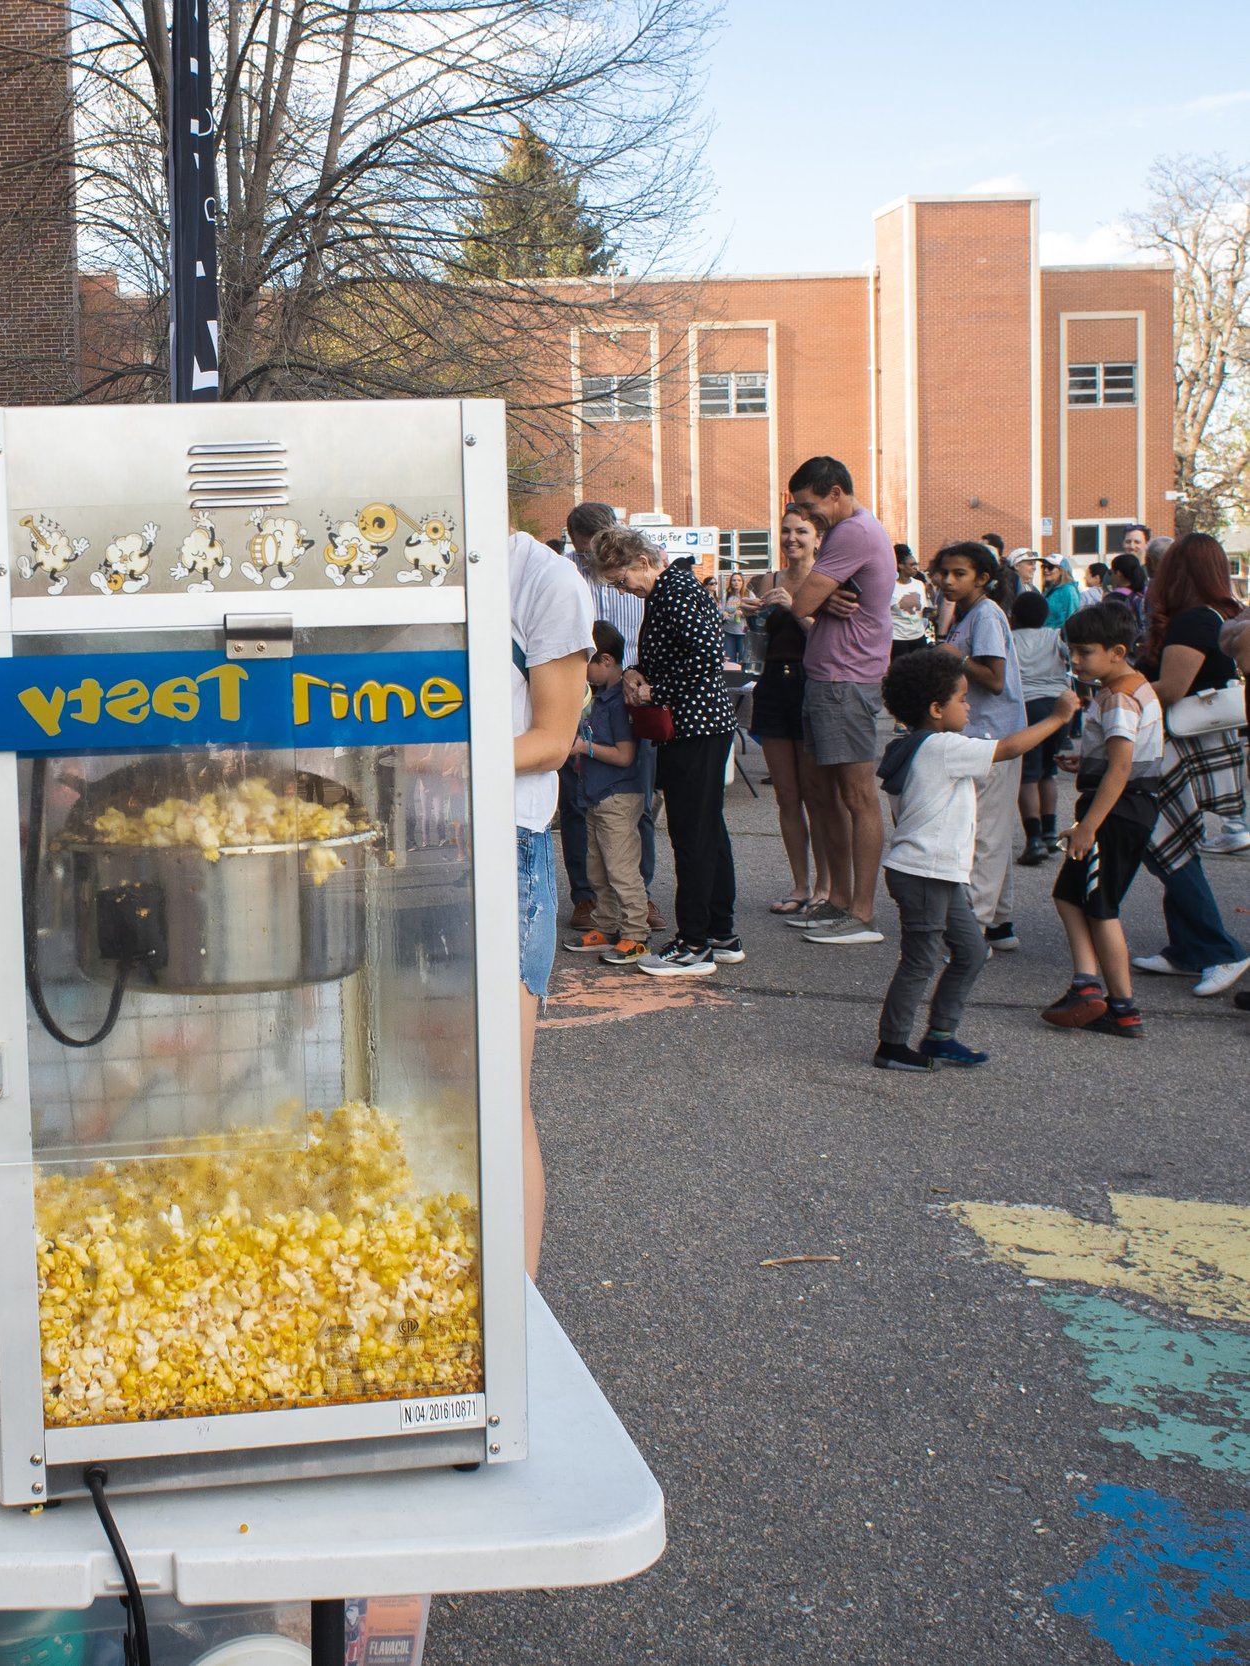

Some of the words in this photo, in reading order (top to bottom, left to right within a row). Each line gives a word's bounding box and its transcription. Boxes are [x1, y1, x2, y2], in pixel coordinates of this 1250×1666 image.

[657, 532, 668, 541] de
[669, 532, 682, 541] Fer
[292, 672, 464, 726] Time
[404, 1406, 412, 1423] N
[369, 1640, 410, 1655] FLAVACOL
